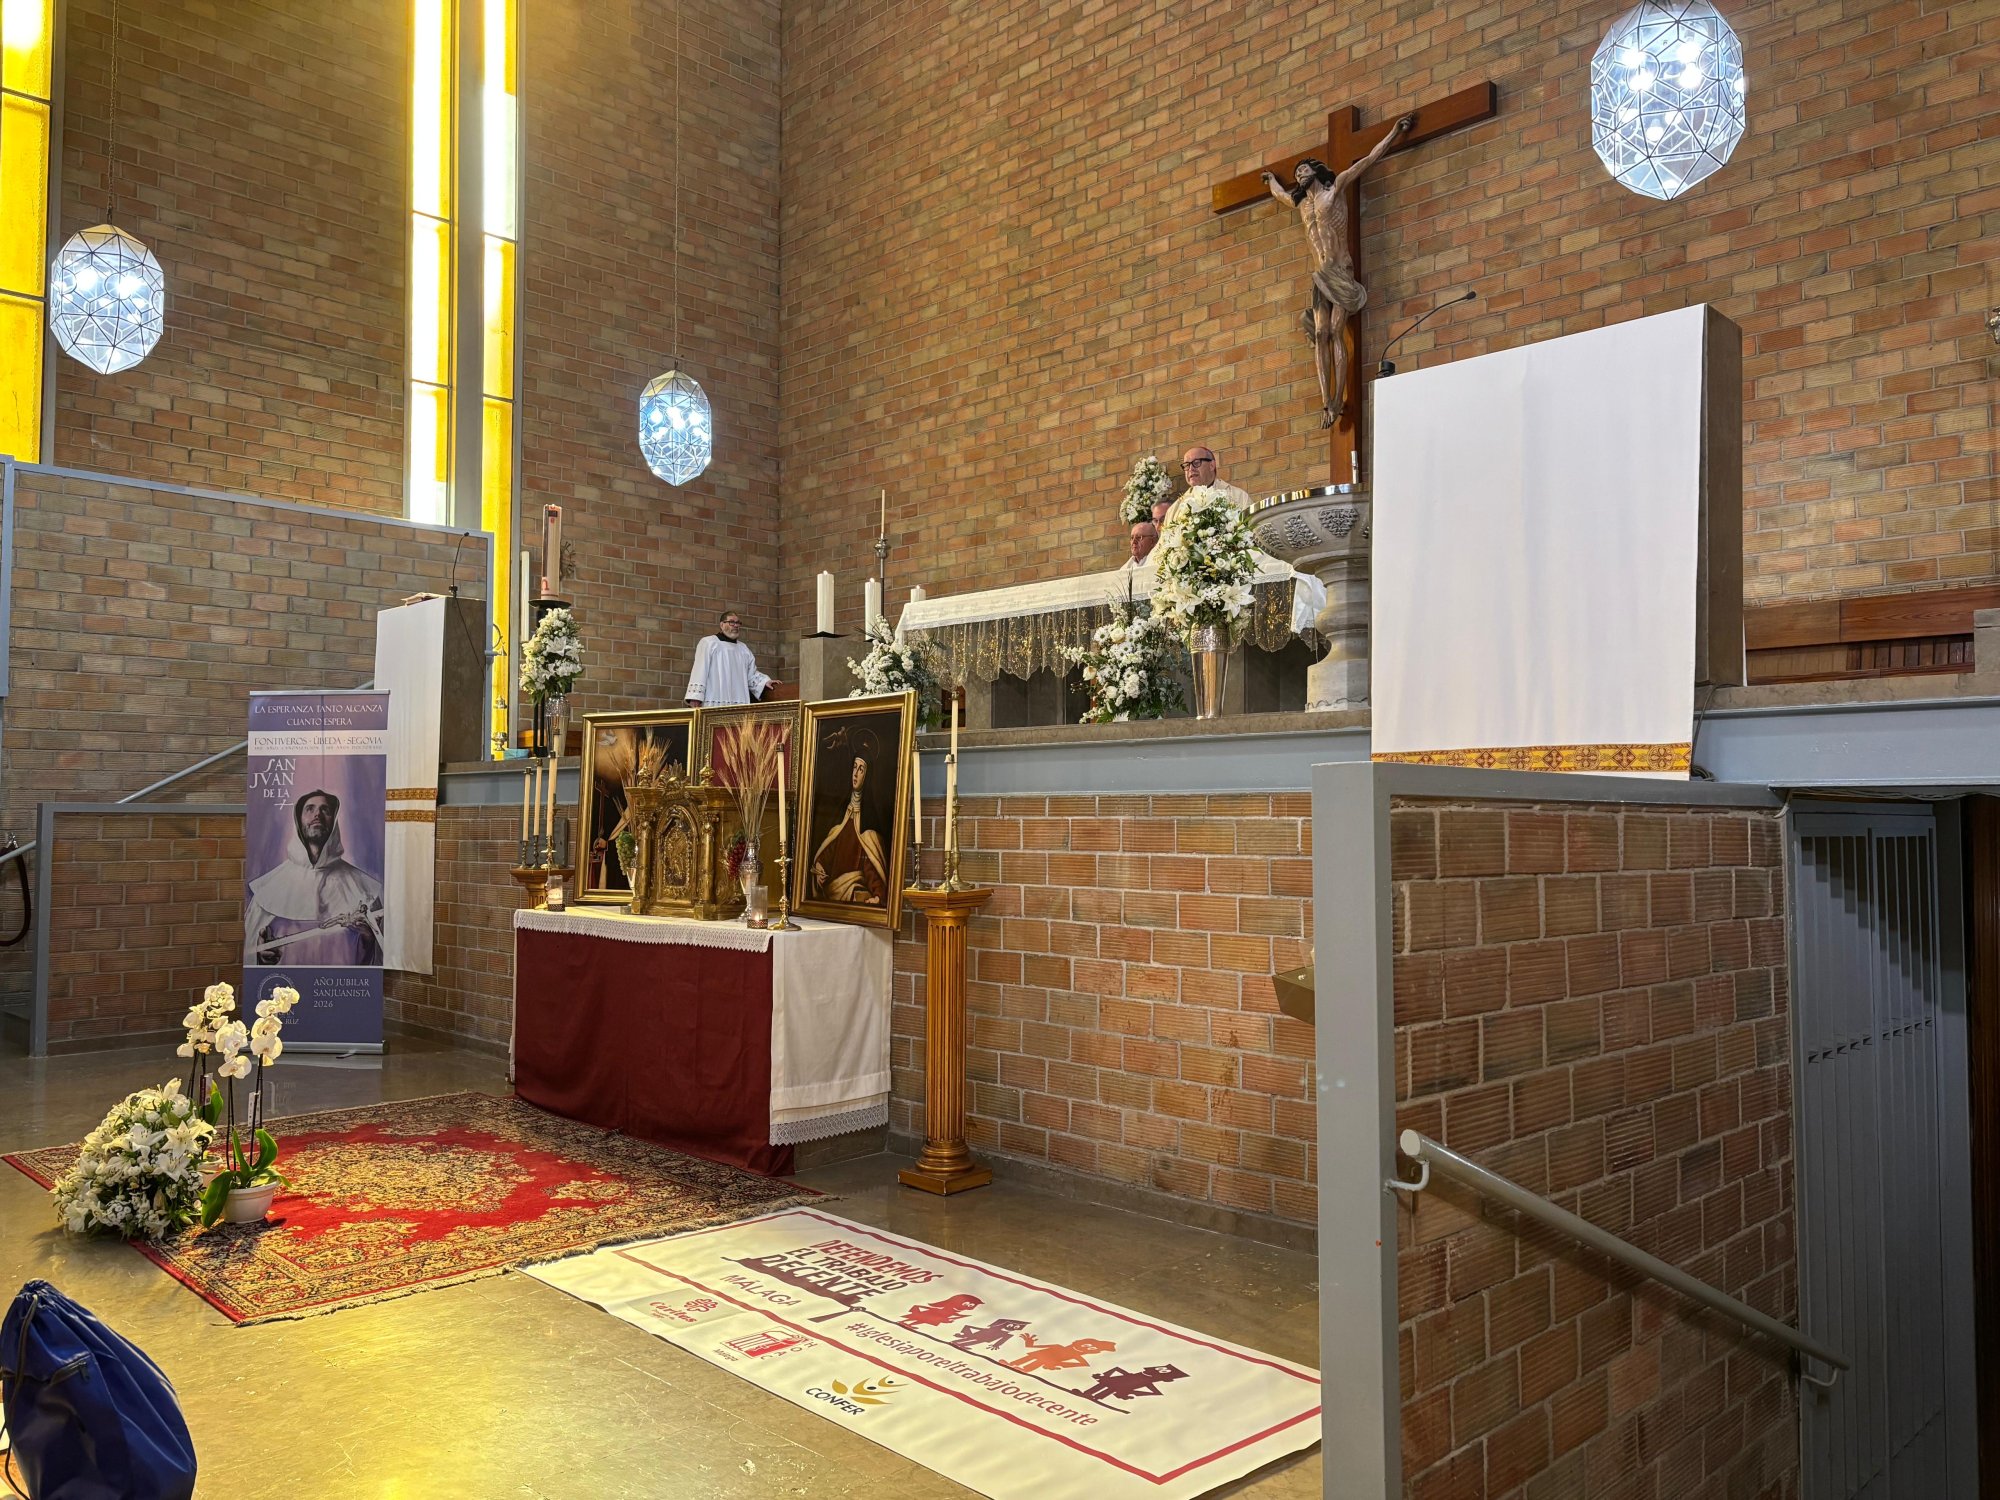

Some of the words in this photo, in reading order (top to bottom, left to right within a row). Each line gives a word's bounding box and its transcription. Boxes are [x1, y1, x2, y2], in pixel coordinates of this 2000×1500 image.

[254, 705, 266, 714] LA
[267, 705, 314, 714] ESPERANZA
[316, 705, 343, 713] TANTO
[344, 704, 384, 713] ALCANZA
[286, 718, 322, 727] CUANTO
[323, 718, 353, 726] ESPERA
[254, 737, 308, 746] FONTIVEROS
[313, 735, 342, 745] ÚBEDA
[347, 736, 383, 745] SEGOVIA
[263, 758, 297, 773] SAN
[263, 788, 275, 798] DE
[277, 788, 290, 798] LA
[313, 977, 334, 987] AÑO
[335, 978, 370, 988] JUBILAR
[313, 989, 371, 998] SANJUANISTA
[313, 1000, 334, 1008] 2026
[809, 1239, 944, 1284] DEFENDEMOS
[785, 1247, 818, 1260] EL
[812, 1256, 908, 1291] TRABAJO
[757, 1253, 886, 1301] DECENTE
[720, 1274, 802, 1307] MÁLAGA
[843, 1321, 1100, 1428] #Iglesiaporeltrabajodecente
[805, 1387, 866, 1416] CONFER
